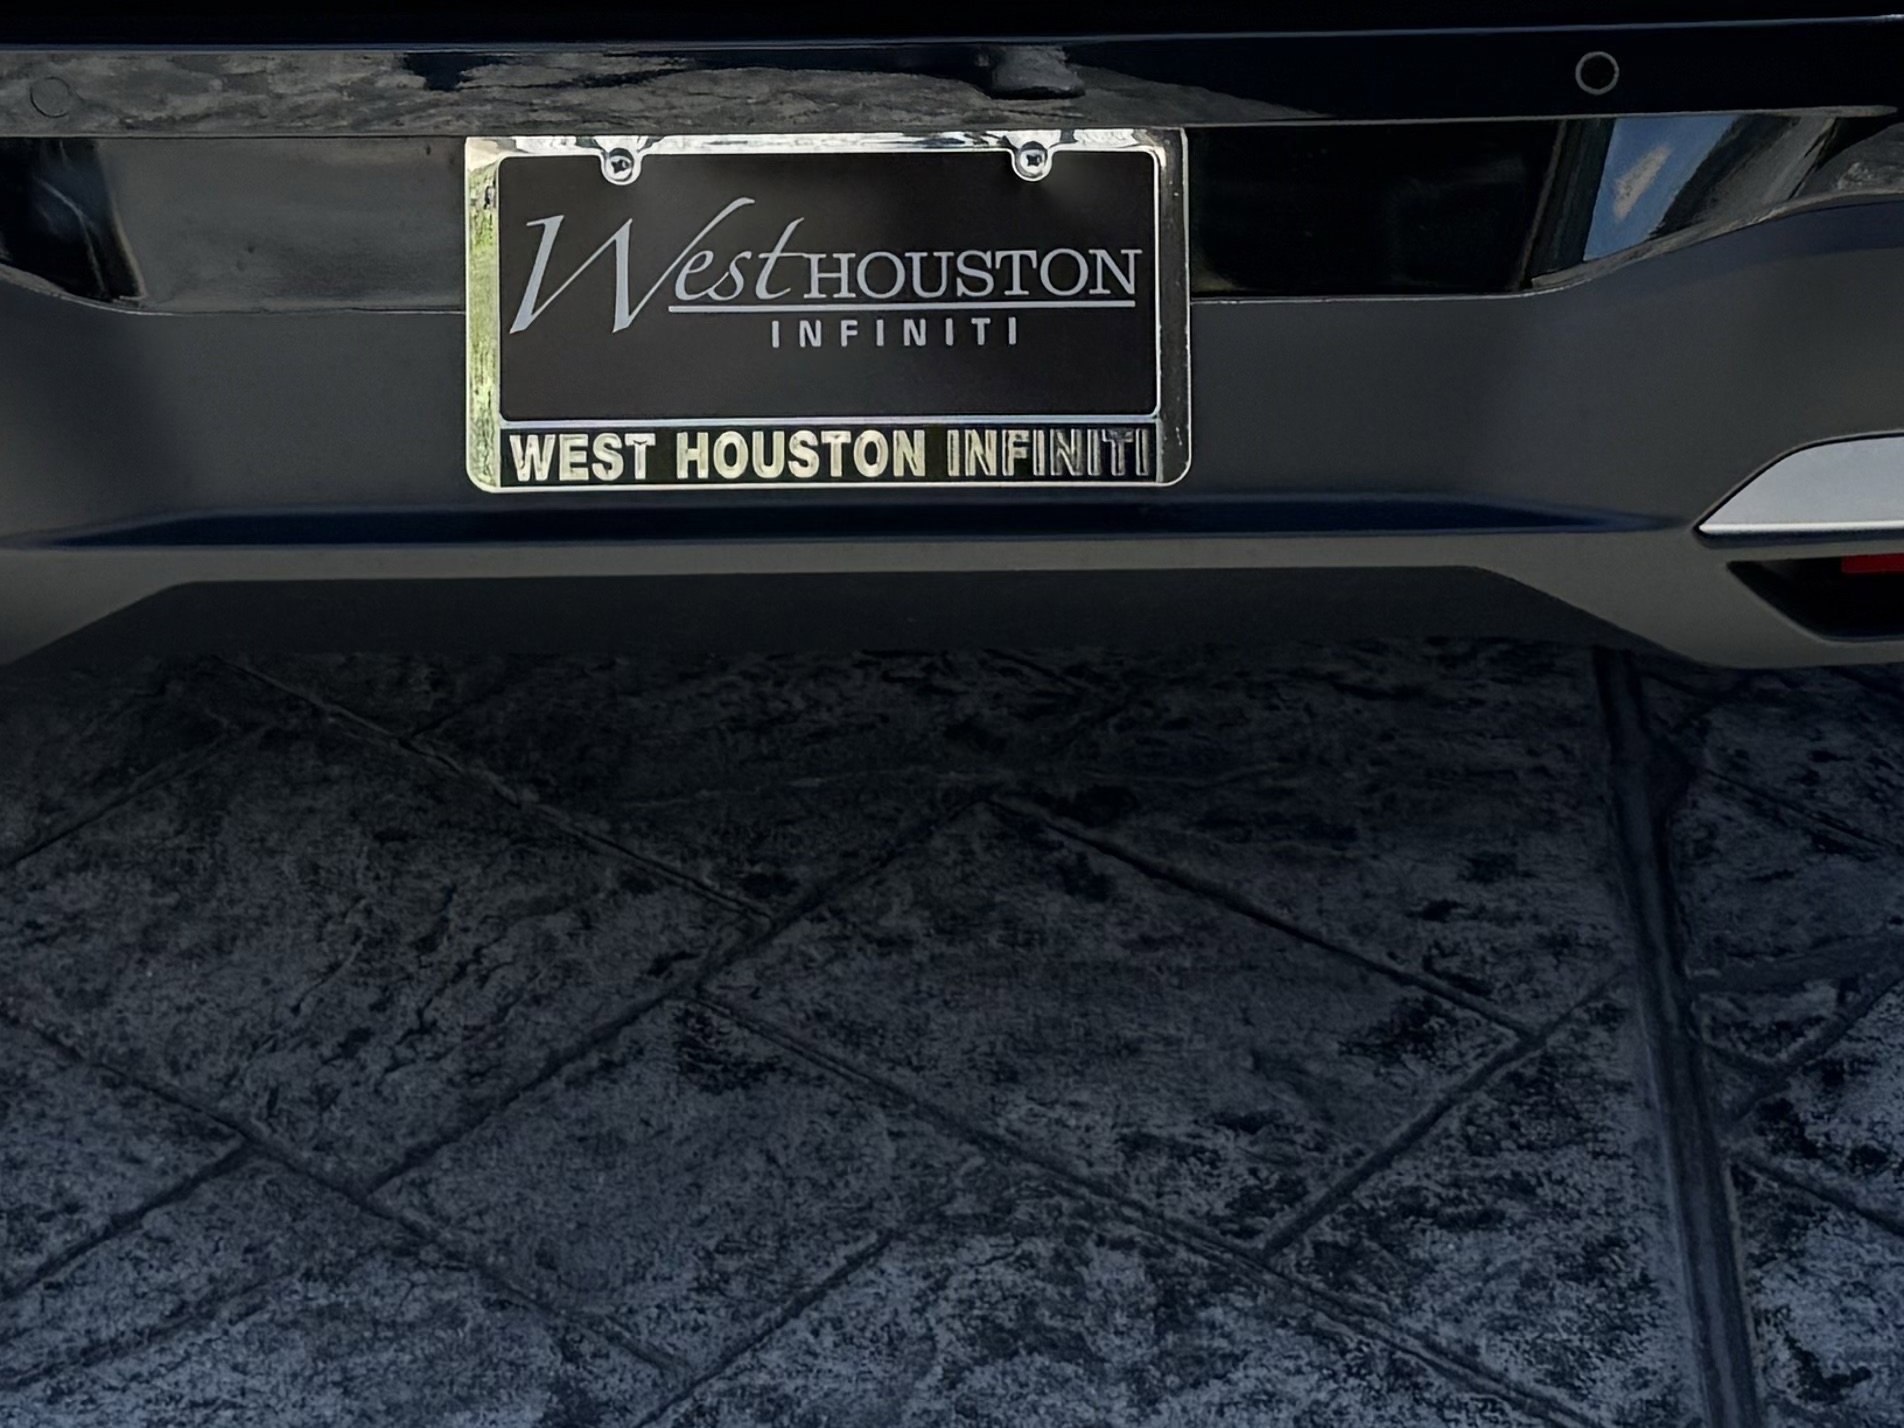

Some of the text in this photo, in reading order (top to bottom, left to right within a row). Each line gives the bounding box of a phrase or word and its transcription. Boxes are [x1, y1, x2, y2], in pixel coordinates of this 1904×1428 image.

[509, 196, 1143, 335] West HOUSTON
[771, 316, 1018, 349] INFINITI
[509, 427, 1152, 483] WEST HOUSTON INFINITI
